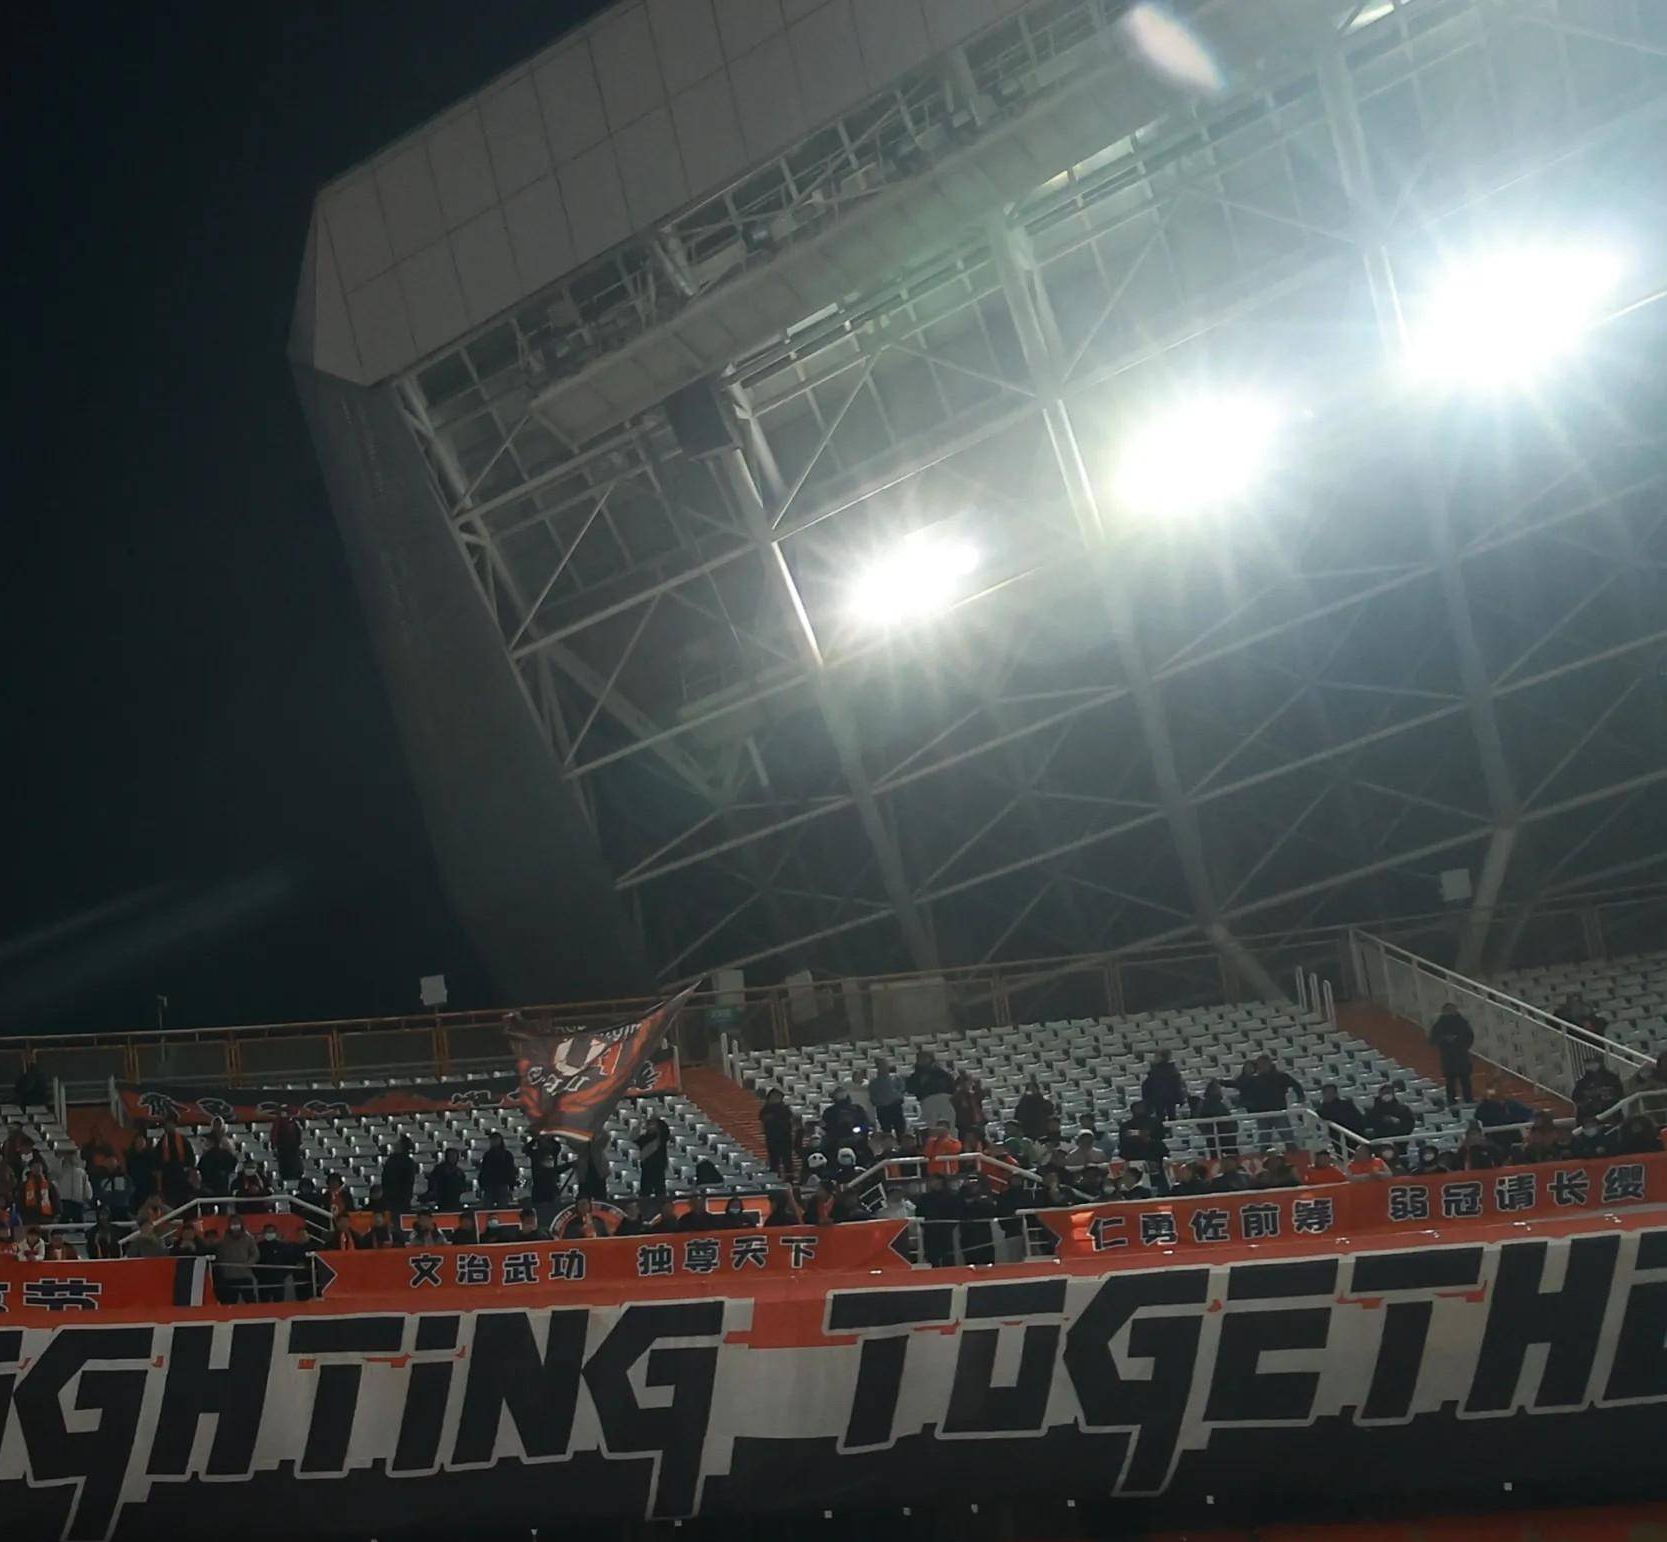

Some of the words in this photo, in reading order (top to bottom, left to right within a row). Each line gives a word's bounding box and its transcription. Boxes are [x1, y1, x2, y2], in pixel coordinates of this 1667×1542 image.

[409, 1252, 587, 1288] 文治武功
[637, 1235, 821, 1277] 独尊天下
